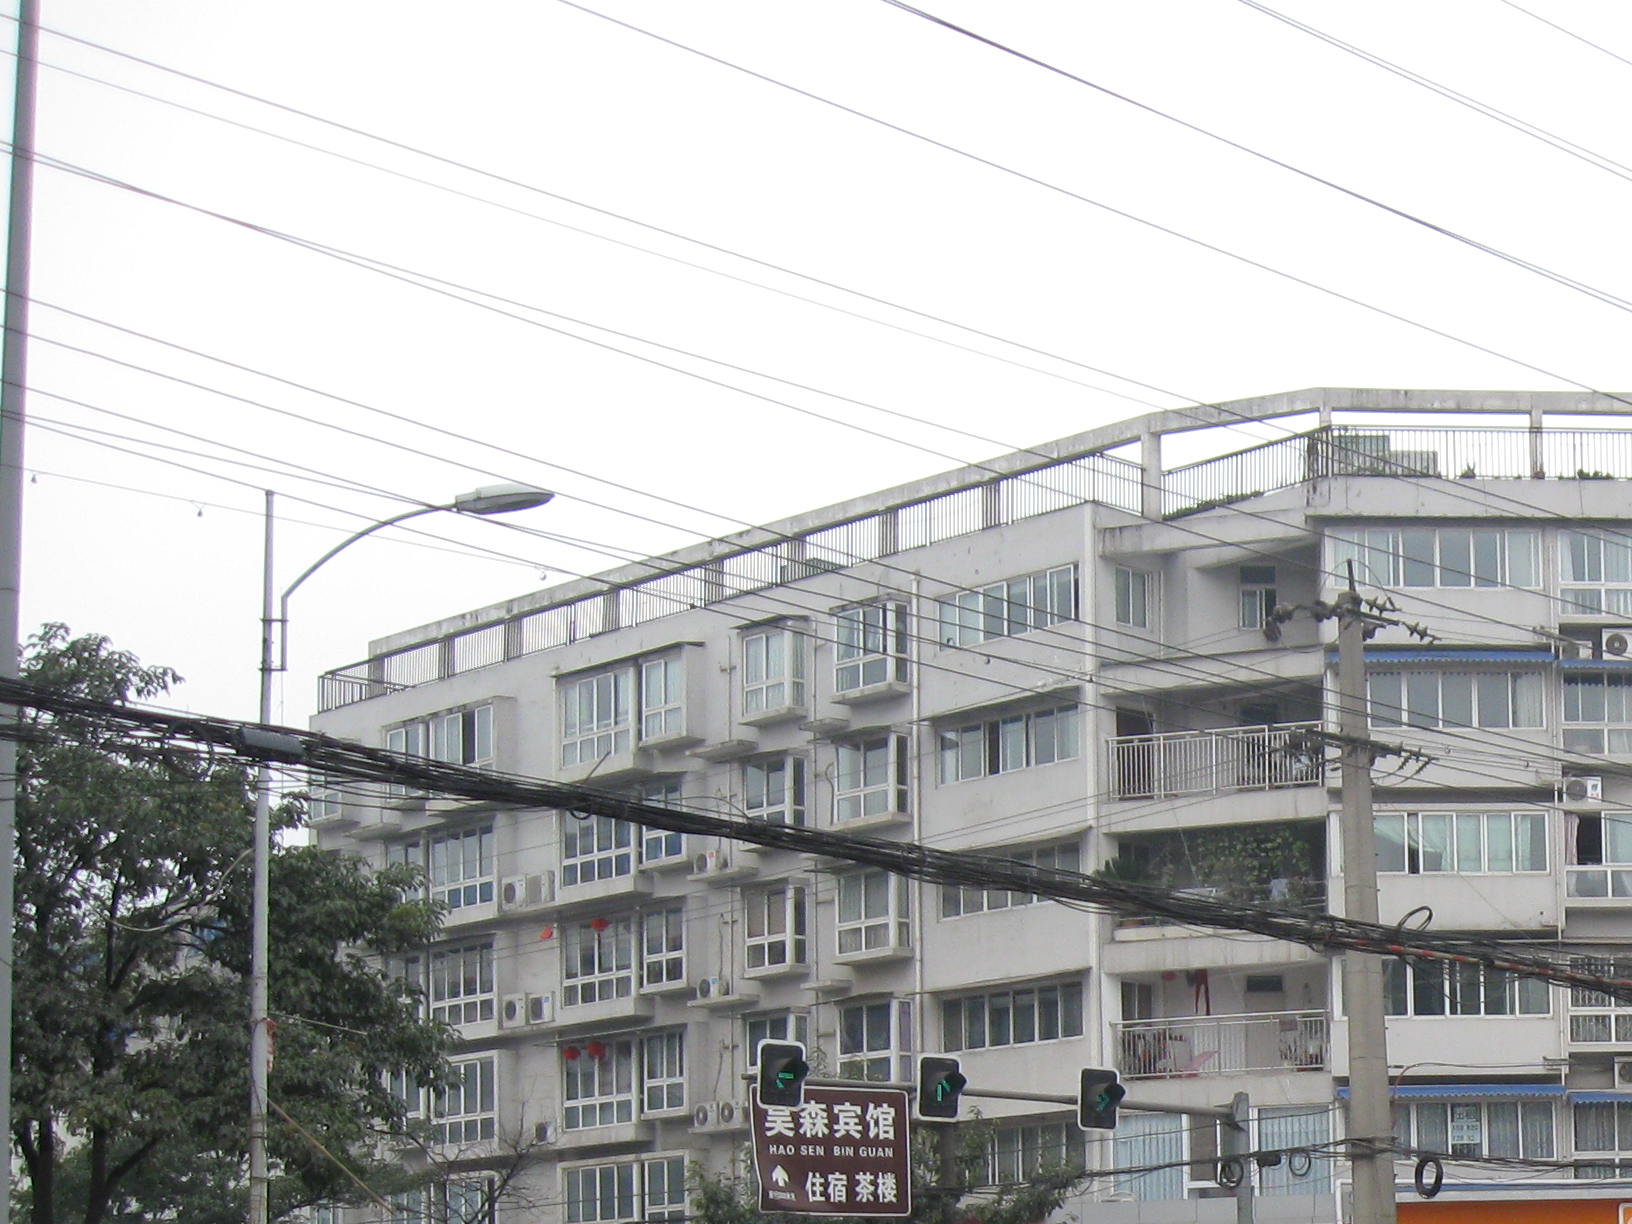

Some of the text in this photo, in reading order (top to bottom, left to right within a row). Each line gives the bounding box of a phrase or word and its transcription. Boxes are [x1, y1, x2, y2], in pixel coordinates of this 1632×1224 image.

[769, 1144, 893, 1158] HAO SEN BIN GUAN
[805, 1171, 897, 1203] 住宿 茶楼
